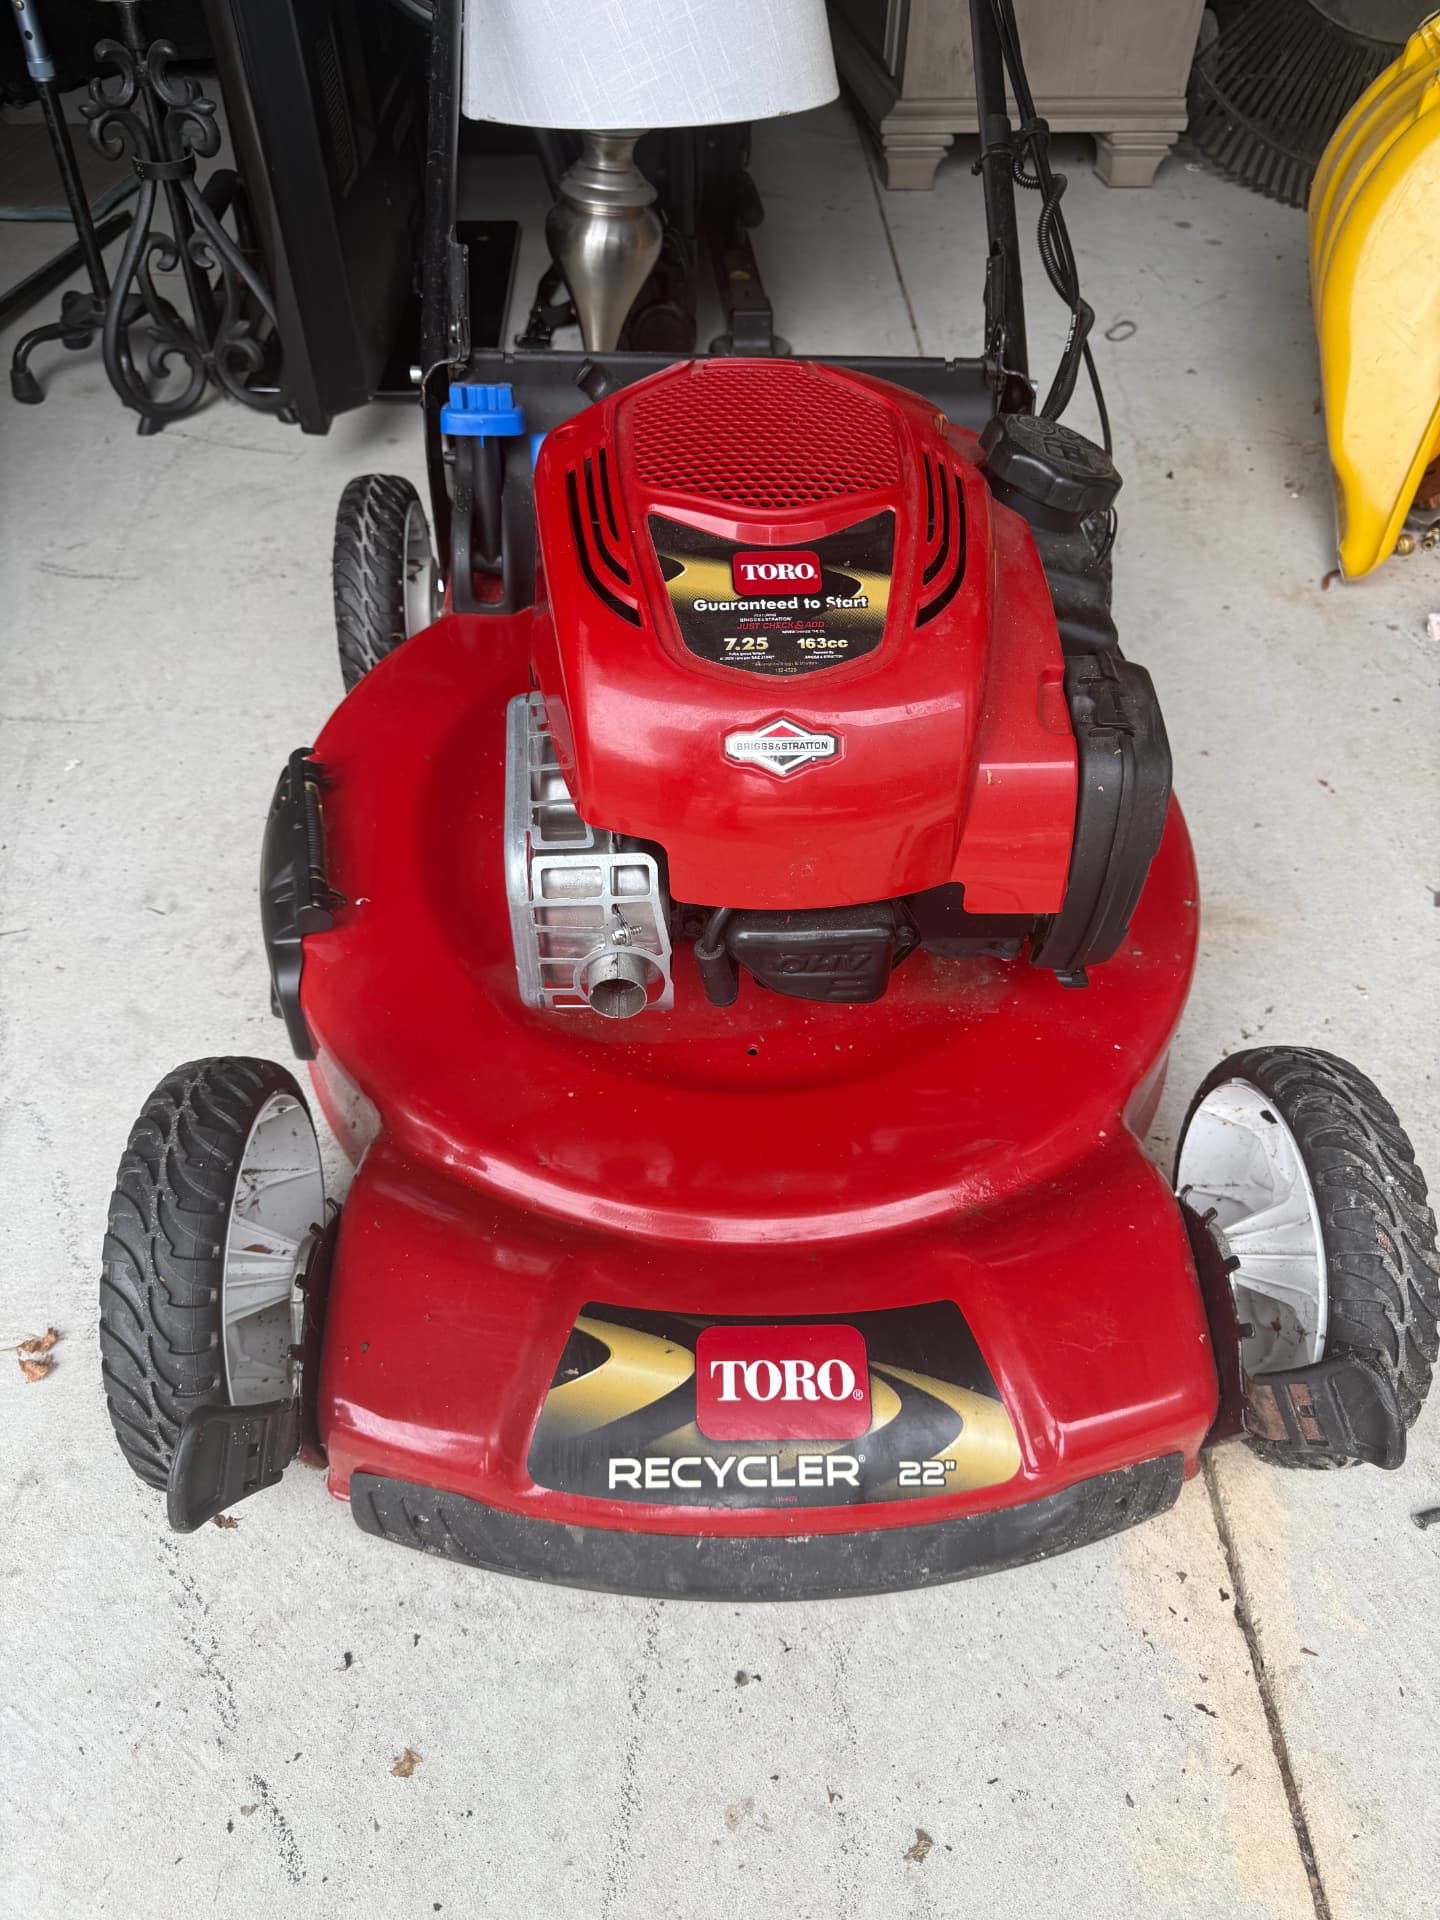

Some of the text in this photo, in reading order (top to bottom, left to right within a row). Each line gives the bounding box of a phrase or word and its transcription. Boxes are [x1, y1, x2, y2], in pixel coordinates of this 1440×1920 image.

[740, 563, 815, 581] TORO
[693, 596, 869, 612] Guaranteed to Start
[736, 621, 761, 630] JUST
[762, 621, 793, 630] CHECK
[805, 621, 826, 629] ADD
[723, 637, 769, 651] 7.25
[797, 638, 849, 649] 163cc
[710, 1358, 856, 1402] TORO
[608, 1455, 957, 1489] RECYCLER 22"
